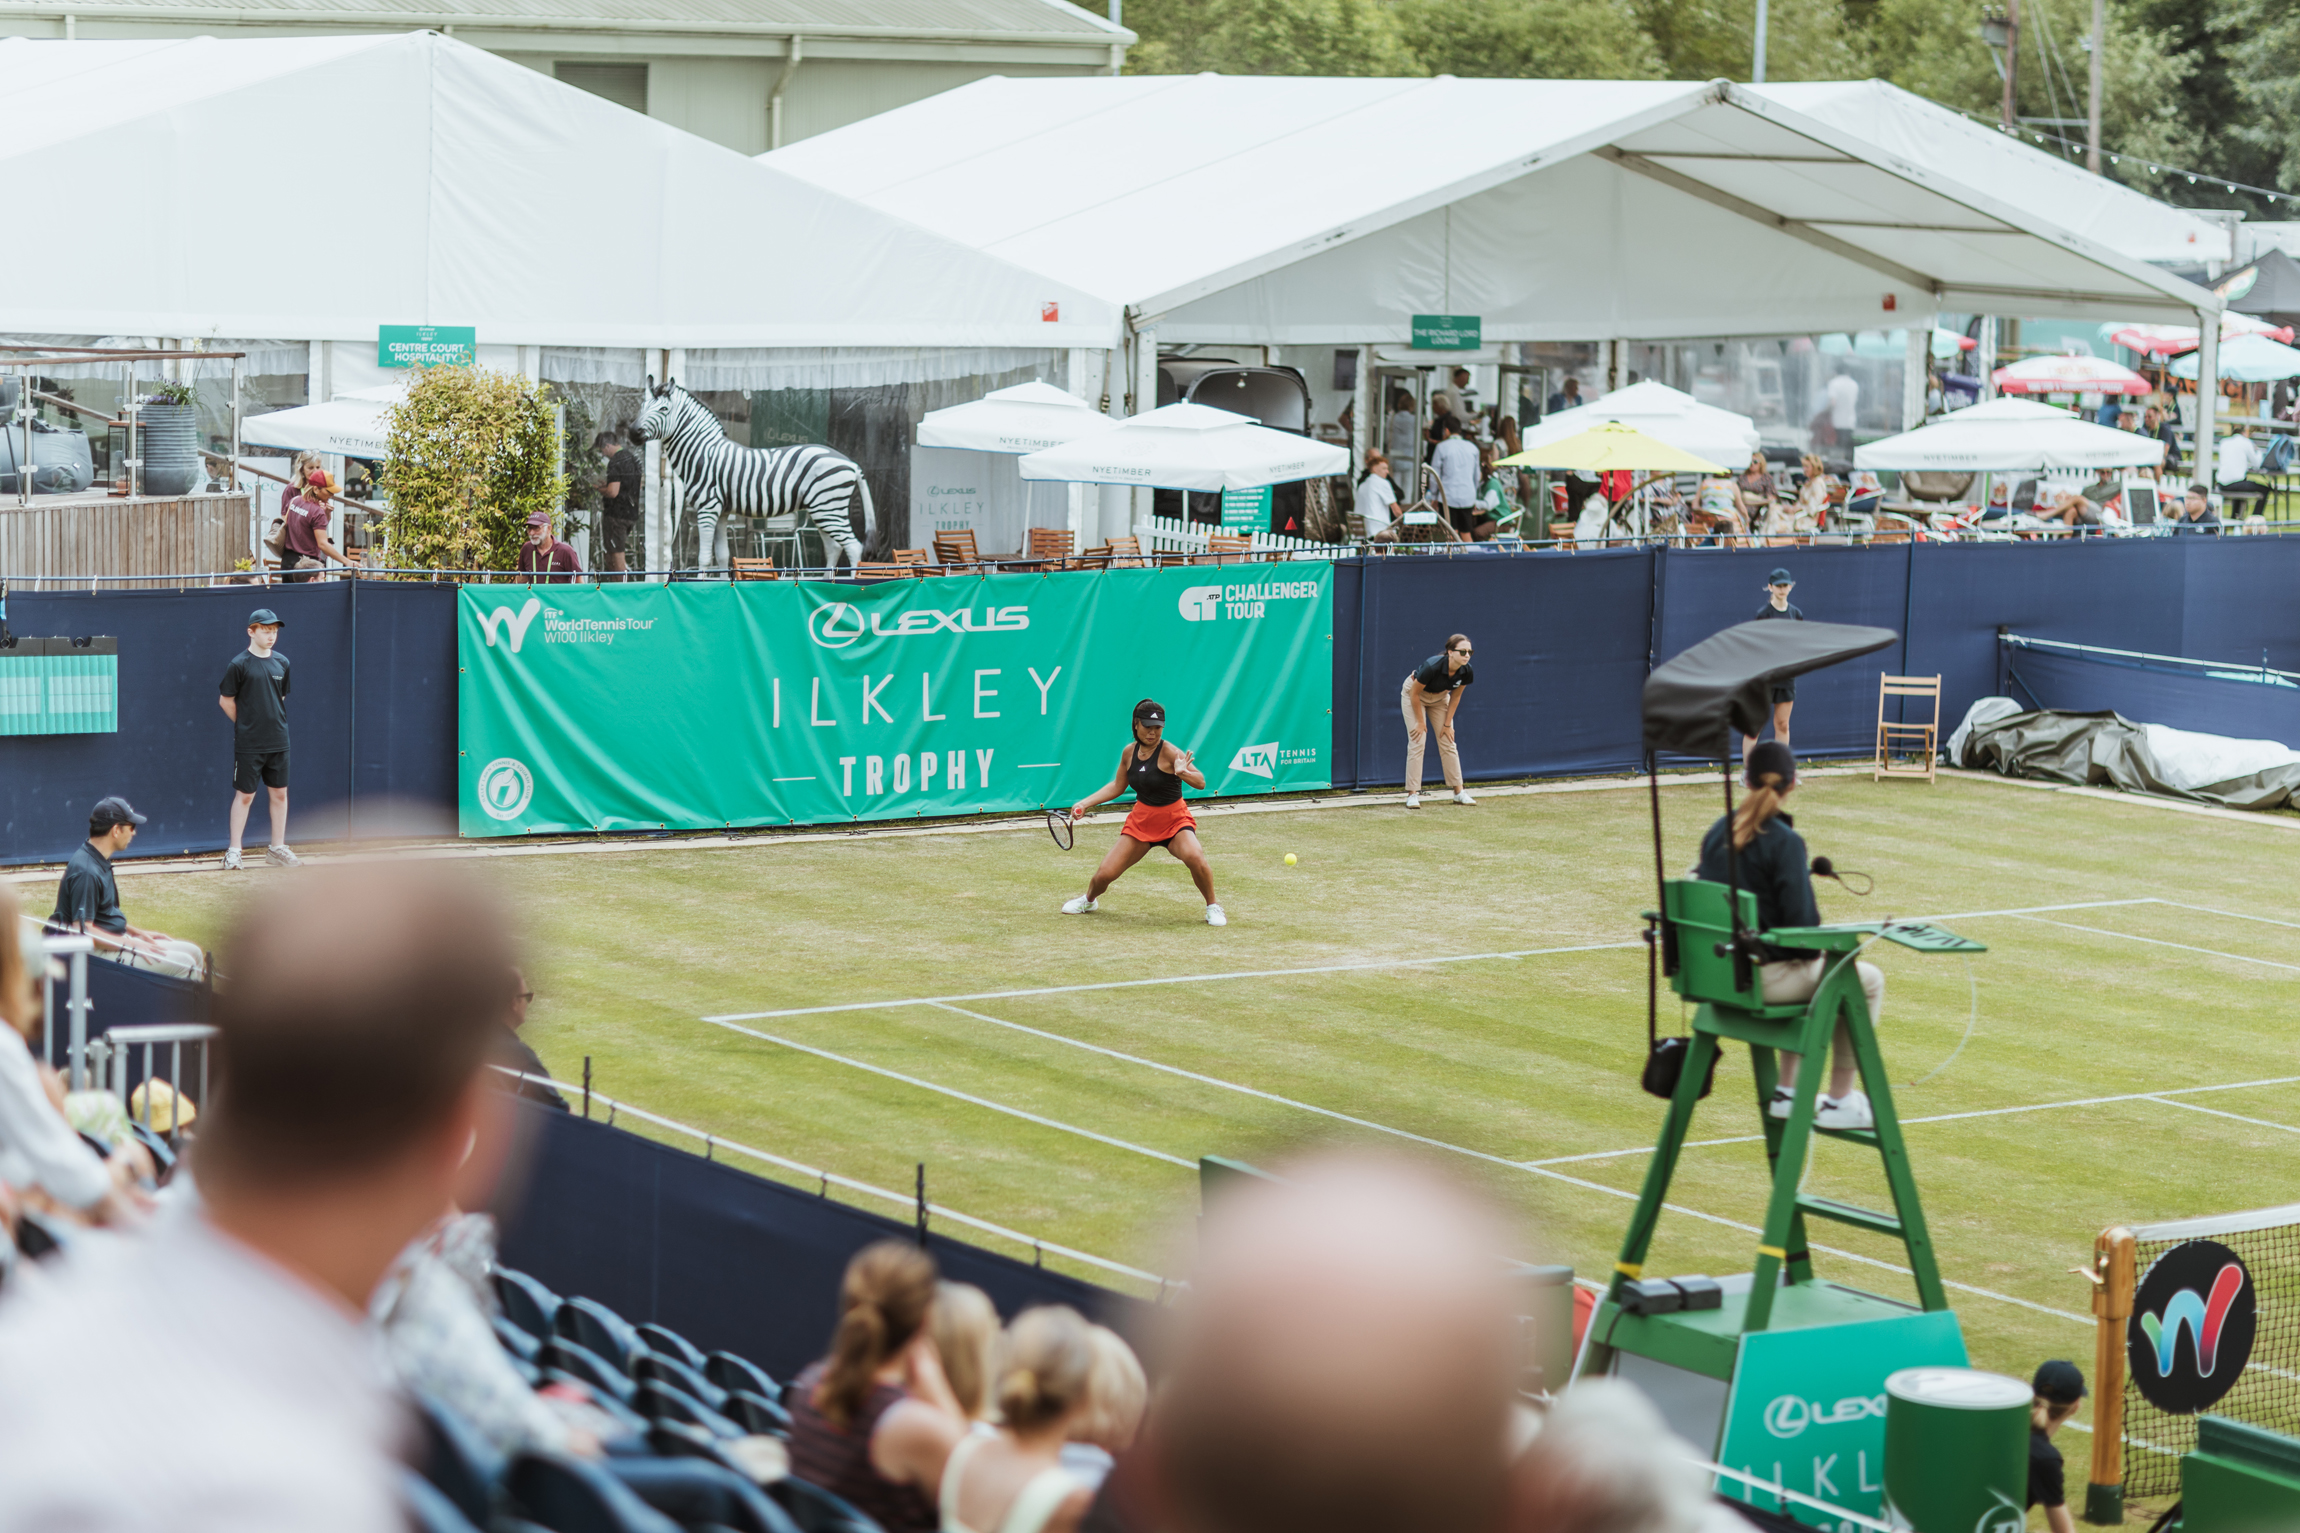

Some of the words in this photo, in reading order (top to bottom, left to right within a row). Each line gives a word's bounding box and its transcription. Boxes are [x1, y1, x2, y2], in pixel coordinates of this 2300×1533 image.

[388, 342, 428, 352] CENTRE
[430, 343, 465, 353] COURT
[394, 352, 458, 362] HOSPITALITY
[776, 432, 808, 444] LEXUS
[1092, 466, 1152, 477] NYETIMBER
[941, 487, 976, 495] LEXUS
[919, 502, 985, 515] ILKLEY
[935, 520, 970, 530] TROPHY
[1225, 581, 1318, 601] CHALLENGER
[544, 611, 558, 619] ITF
[1225, 602, 1265, 620] TOUR
[871, 605, 1030, 636] LEXUS
[544, 631, 577, 643] W100
[580, 630, 614, 646] Ilkley
[773, 665, 1062, 728] ILKLEY
[1279, 748, 1316, 758] TENNIS
[1241, 752, 1274, 771] LTA
[492, 760, 510, 769] TENNIS
[517, 764, 531, 784] SQUASH
[839, 748, 994, 797] TROPHY
[1811, 1394, 1887, 1425] LEX
[1742, 1449, 1881, 1504] ILKL
